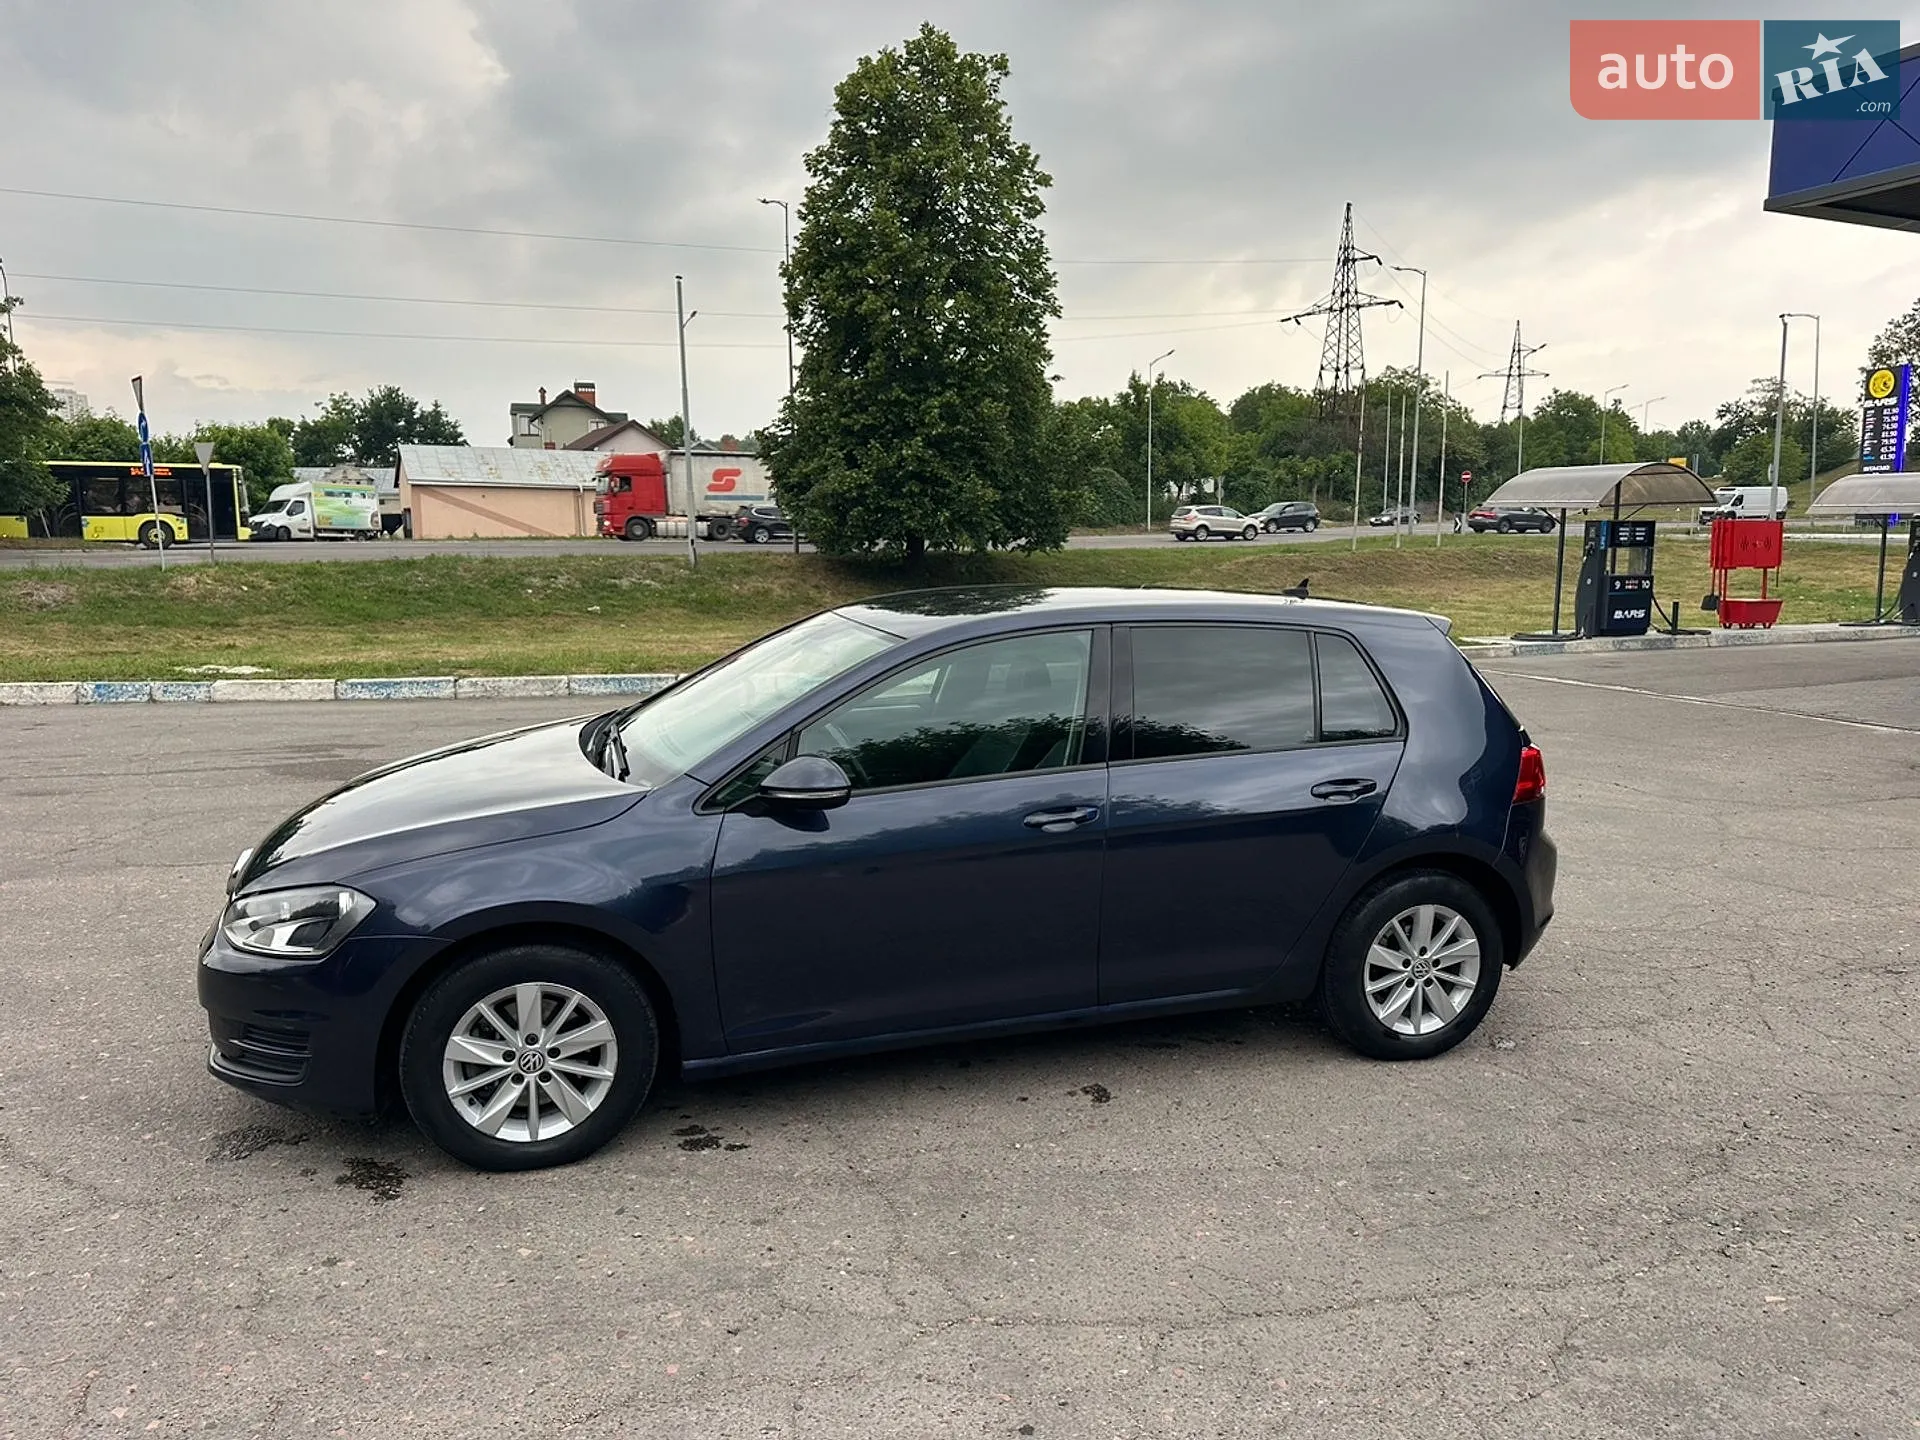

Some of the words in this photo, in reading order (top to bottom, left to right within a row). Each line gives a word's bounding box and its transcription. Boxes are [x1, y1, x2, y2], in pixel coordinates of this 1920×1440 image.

[1614, 579, 1621, 590] 9
[1641, 580, 1651, 589] 10
[1613, 609, 1646, 619] BARS
